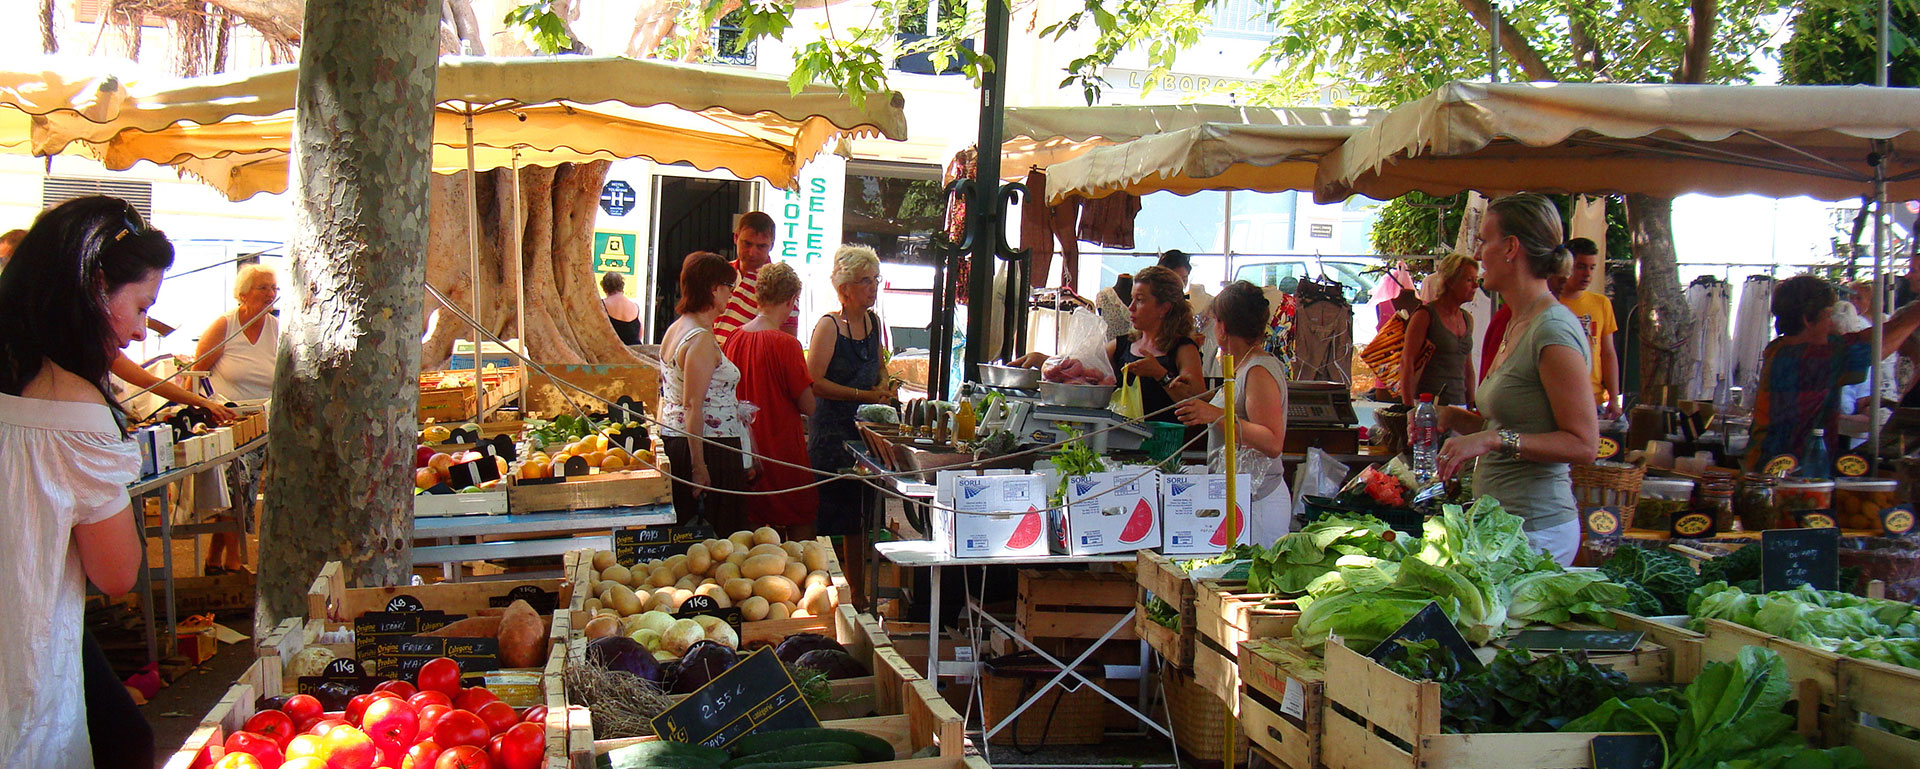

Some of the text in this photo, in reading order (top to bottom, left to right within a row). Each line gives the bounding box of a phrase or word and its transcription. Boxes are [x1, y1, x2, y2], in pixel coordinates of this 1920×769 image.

[611, 191, 624, 206] H
[782, 189, 801, 262] OTE
[1070, 476, 1092, 484] SORLI
[639, 530, 659, 541] PAYS
[688, 597, 708, 609] 1Kg
[333, 660, 355, 673] 1Kg
[300, 683, 316, 694] Pri
